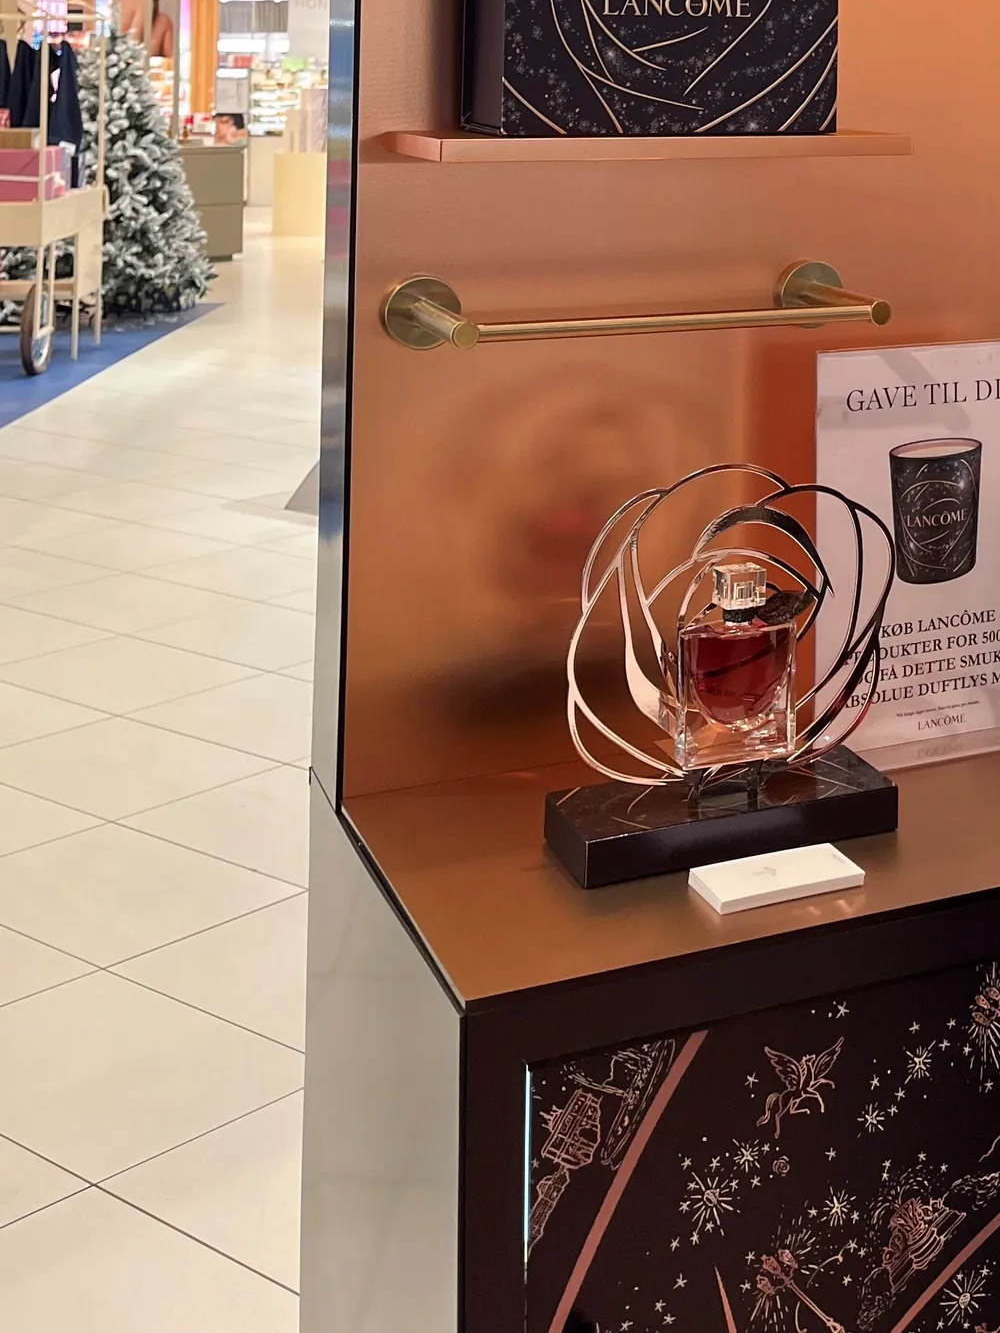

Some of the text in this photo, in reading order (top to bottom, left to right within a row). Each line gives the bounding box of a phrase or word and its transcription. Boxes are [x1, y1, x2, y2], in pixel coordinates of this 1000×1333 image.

[846, 384, 918, 412] GAVE
[923, 381, 968, 406] TIL
[906, 508, 968, 528] LANCÔME
[881, 609, 997, 639] KØB LANCÔME
[946, 632, 979, 650] FOR
[880, 664, 898, 681] FÅ
[902, 656, 956, 678] DETTE
[845, 685, 914, 709] BSOLUE
[917, 673, 988, 697] DUFTLYS
[917, 713, 966, 731] LANCÔME
